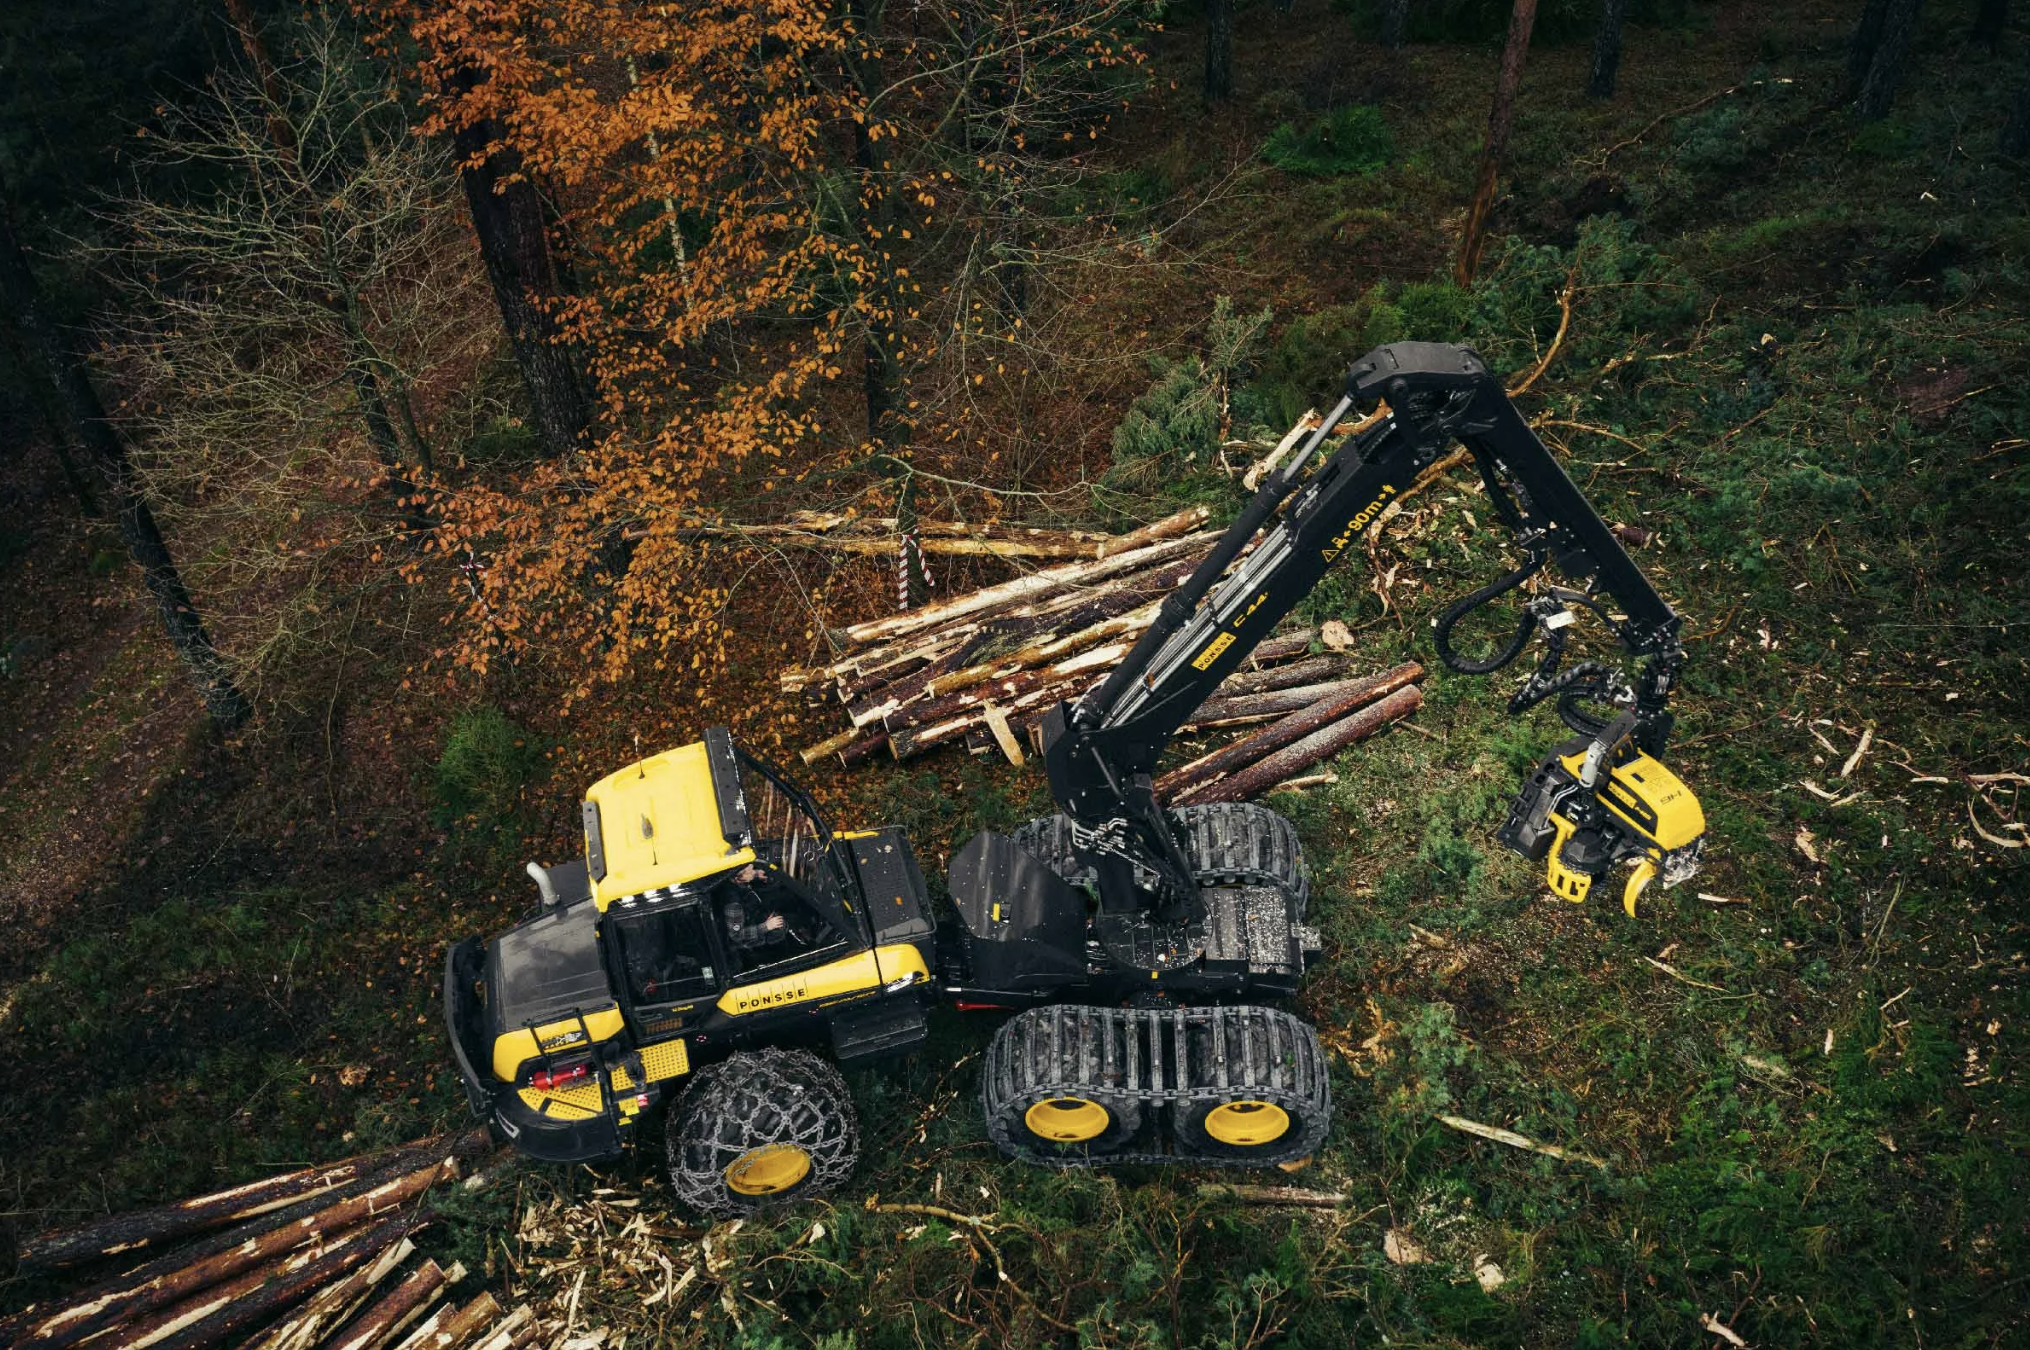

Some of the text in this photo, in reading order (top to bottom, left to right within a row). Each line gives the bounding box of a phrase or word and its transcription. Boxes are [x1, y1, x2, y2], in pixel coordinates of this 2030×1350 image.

[1348, 501, 1383, 531] 90m
[1198, 635, 1233, 669] PONSSE
[739, 988, 805, 1009] PONSSE
